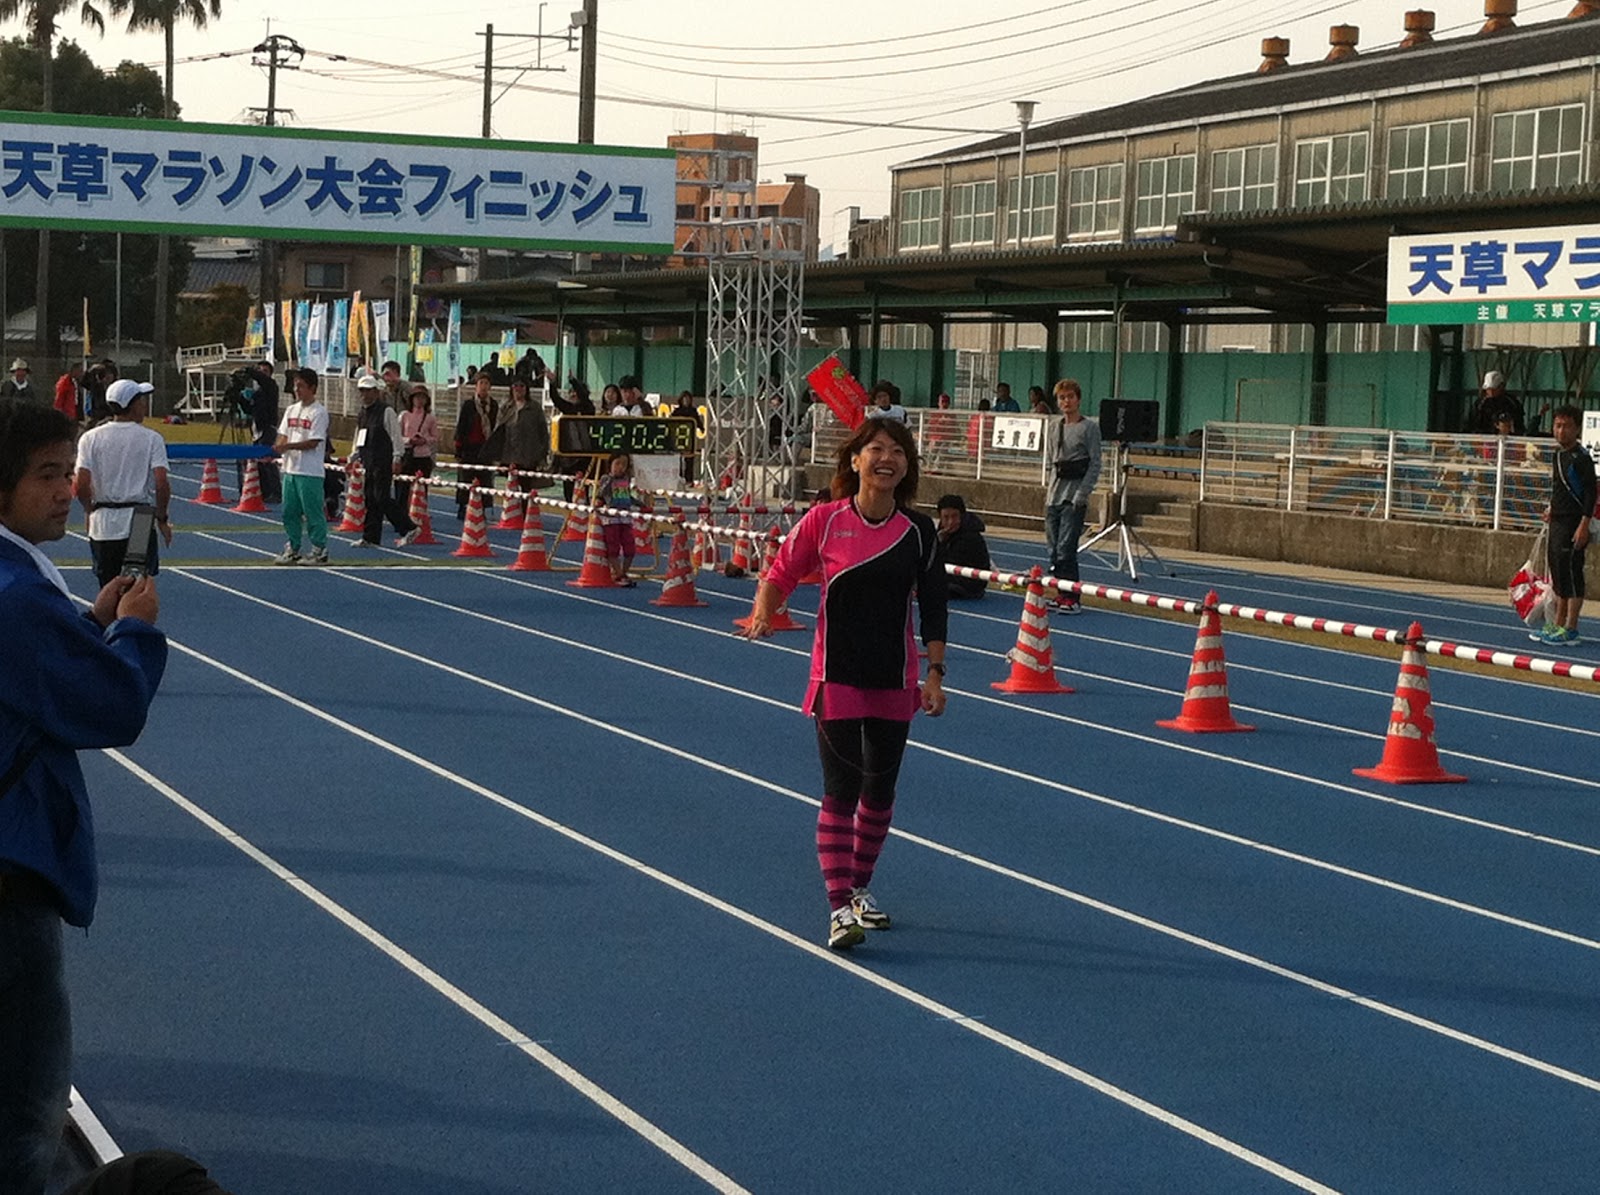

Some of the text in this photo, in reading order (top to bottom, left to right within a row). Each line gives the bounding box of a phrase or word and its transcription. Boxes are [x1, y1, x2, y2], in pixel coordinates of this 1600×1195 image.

[2, 140, 650, 223] 天草マラソン大会フィニッシュ
[1477, 304, 1509, 320] 主催
